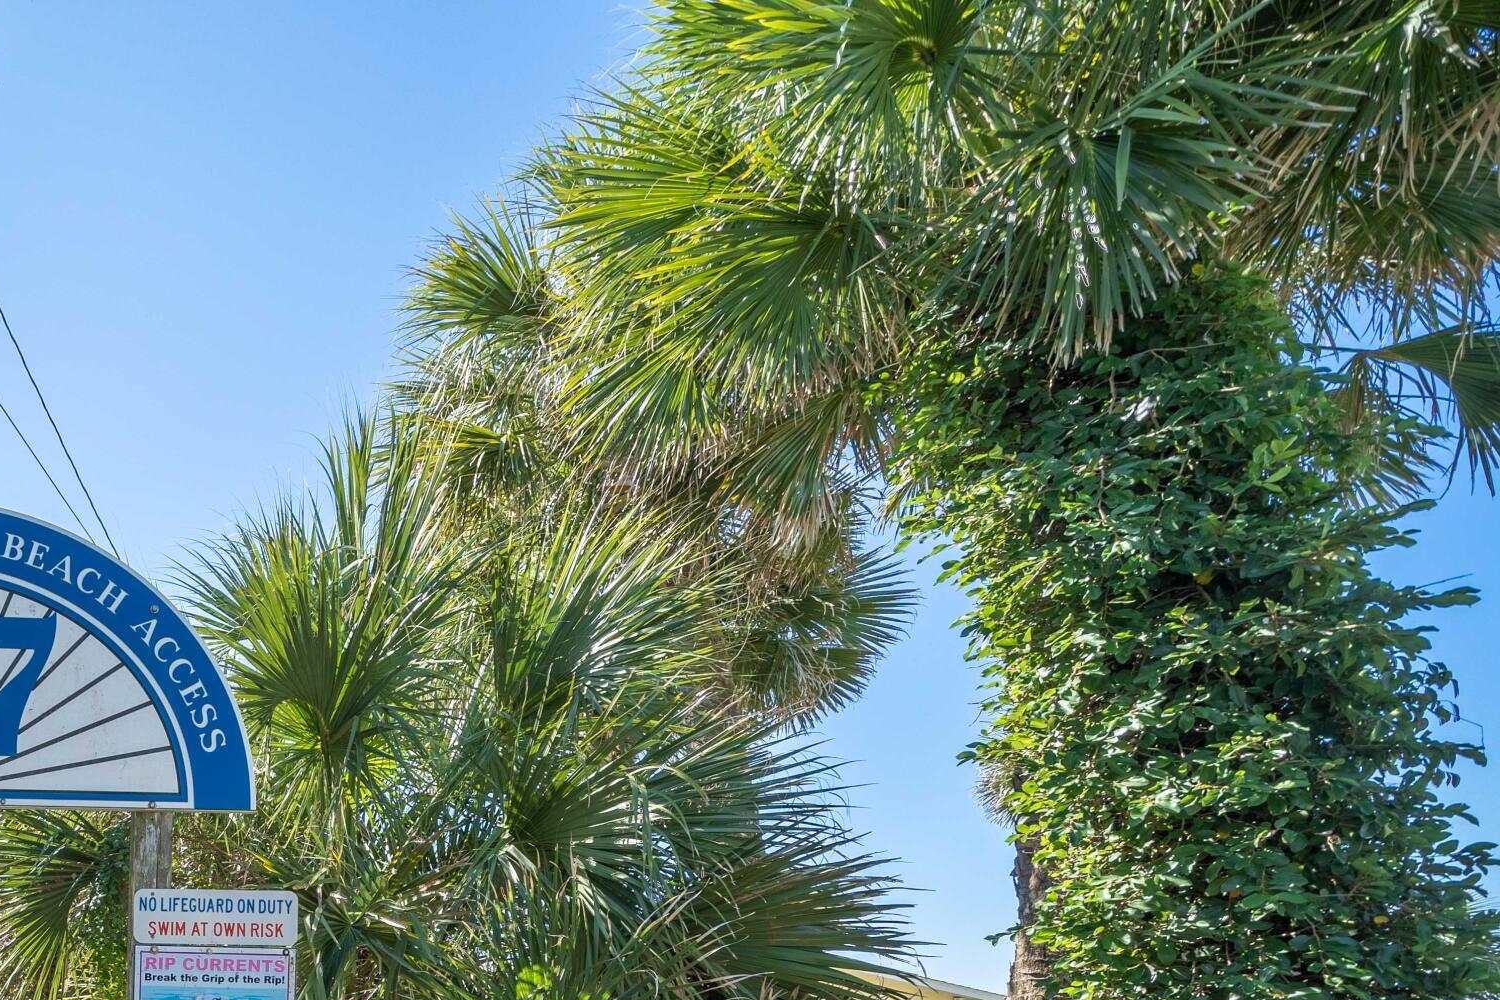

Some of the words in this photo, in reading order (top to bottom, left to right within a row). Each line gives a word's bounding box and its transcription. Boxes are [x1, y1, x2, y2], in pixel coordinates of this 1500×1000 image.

[0, 534, 129, 615] BEACH
[130, 618, 227, 755] ACCESS
[139, 897, 156, 912] NO
[161, 897, 233, 913] LIFEGUARD
[238, 899, 255, 914] ON
[259, 900, 293, 914] DUTY
[148, 922, 185, 936] SWIM
[191, 922, 208, 936] AT
[214, 922, 246, 937] OWN
[251, 923, 283, 937] RISK
[145, 958, 175, 970] RIP
[183, 958, 285, 973] CURRENTS
[145, 973, 177, 982] Break
[181, 974, 198, 982] the
[202, 974, 224, 985] Grip
[228, 975, 239, 983] of
[242, 975, 260, 984] the
[264, 976, 285, 985] Rip!
